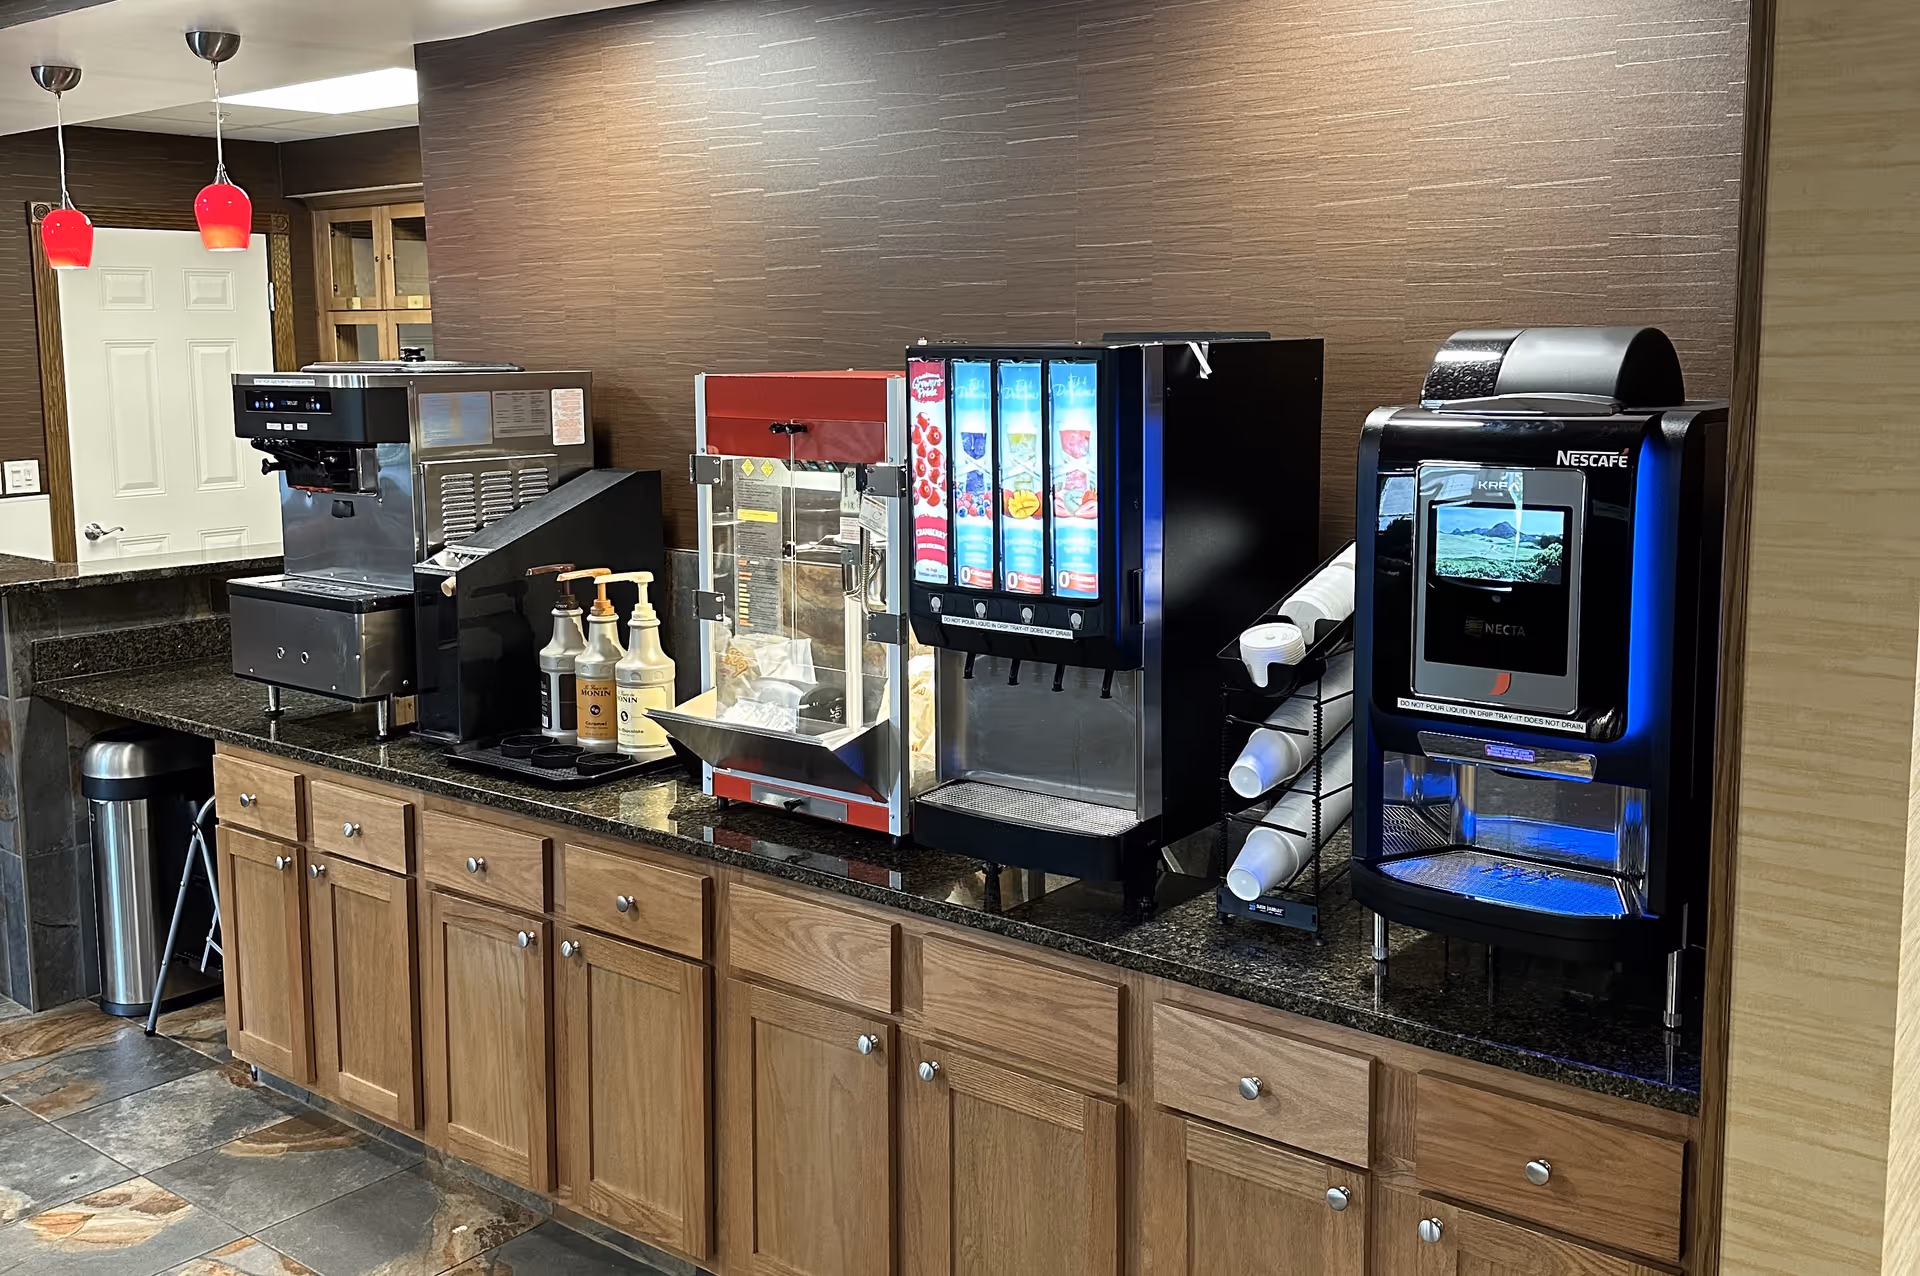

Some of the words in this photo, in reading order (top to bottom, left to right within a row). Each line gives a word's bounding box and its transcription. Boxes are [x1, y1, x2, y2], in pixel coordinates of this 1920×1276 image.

[1478, 480, 1520, 492] KREA
[961, 566, 971, 584] 0
[1007, 572, 1018, 589] 0
[1059, 571, 1070, 588] 0
[1485, 623, 1526, 637] NECTA
[581, 689, 611, 697] MONIN
[1411, 701, 1424, 709] NOT
[1426, 703, 1445, 711] POUR
[1446, 706, 1468, 715] LIQUID
[1477, 710, 1493, 718] DRIP
[1524, 716, 1544, 725] DOES
[1545, 719, 1560, 728] NOT
[1561, 721, 1584, 730] DRAIN
